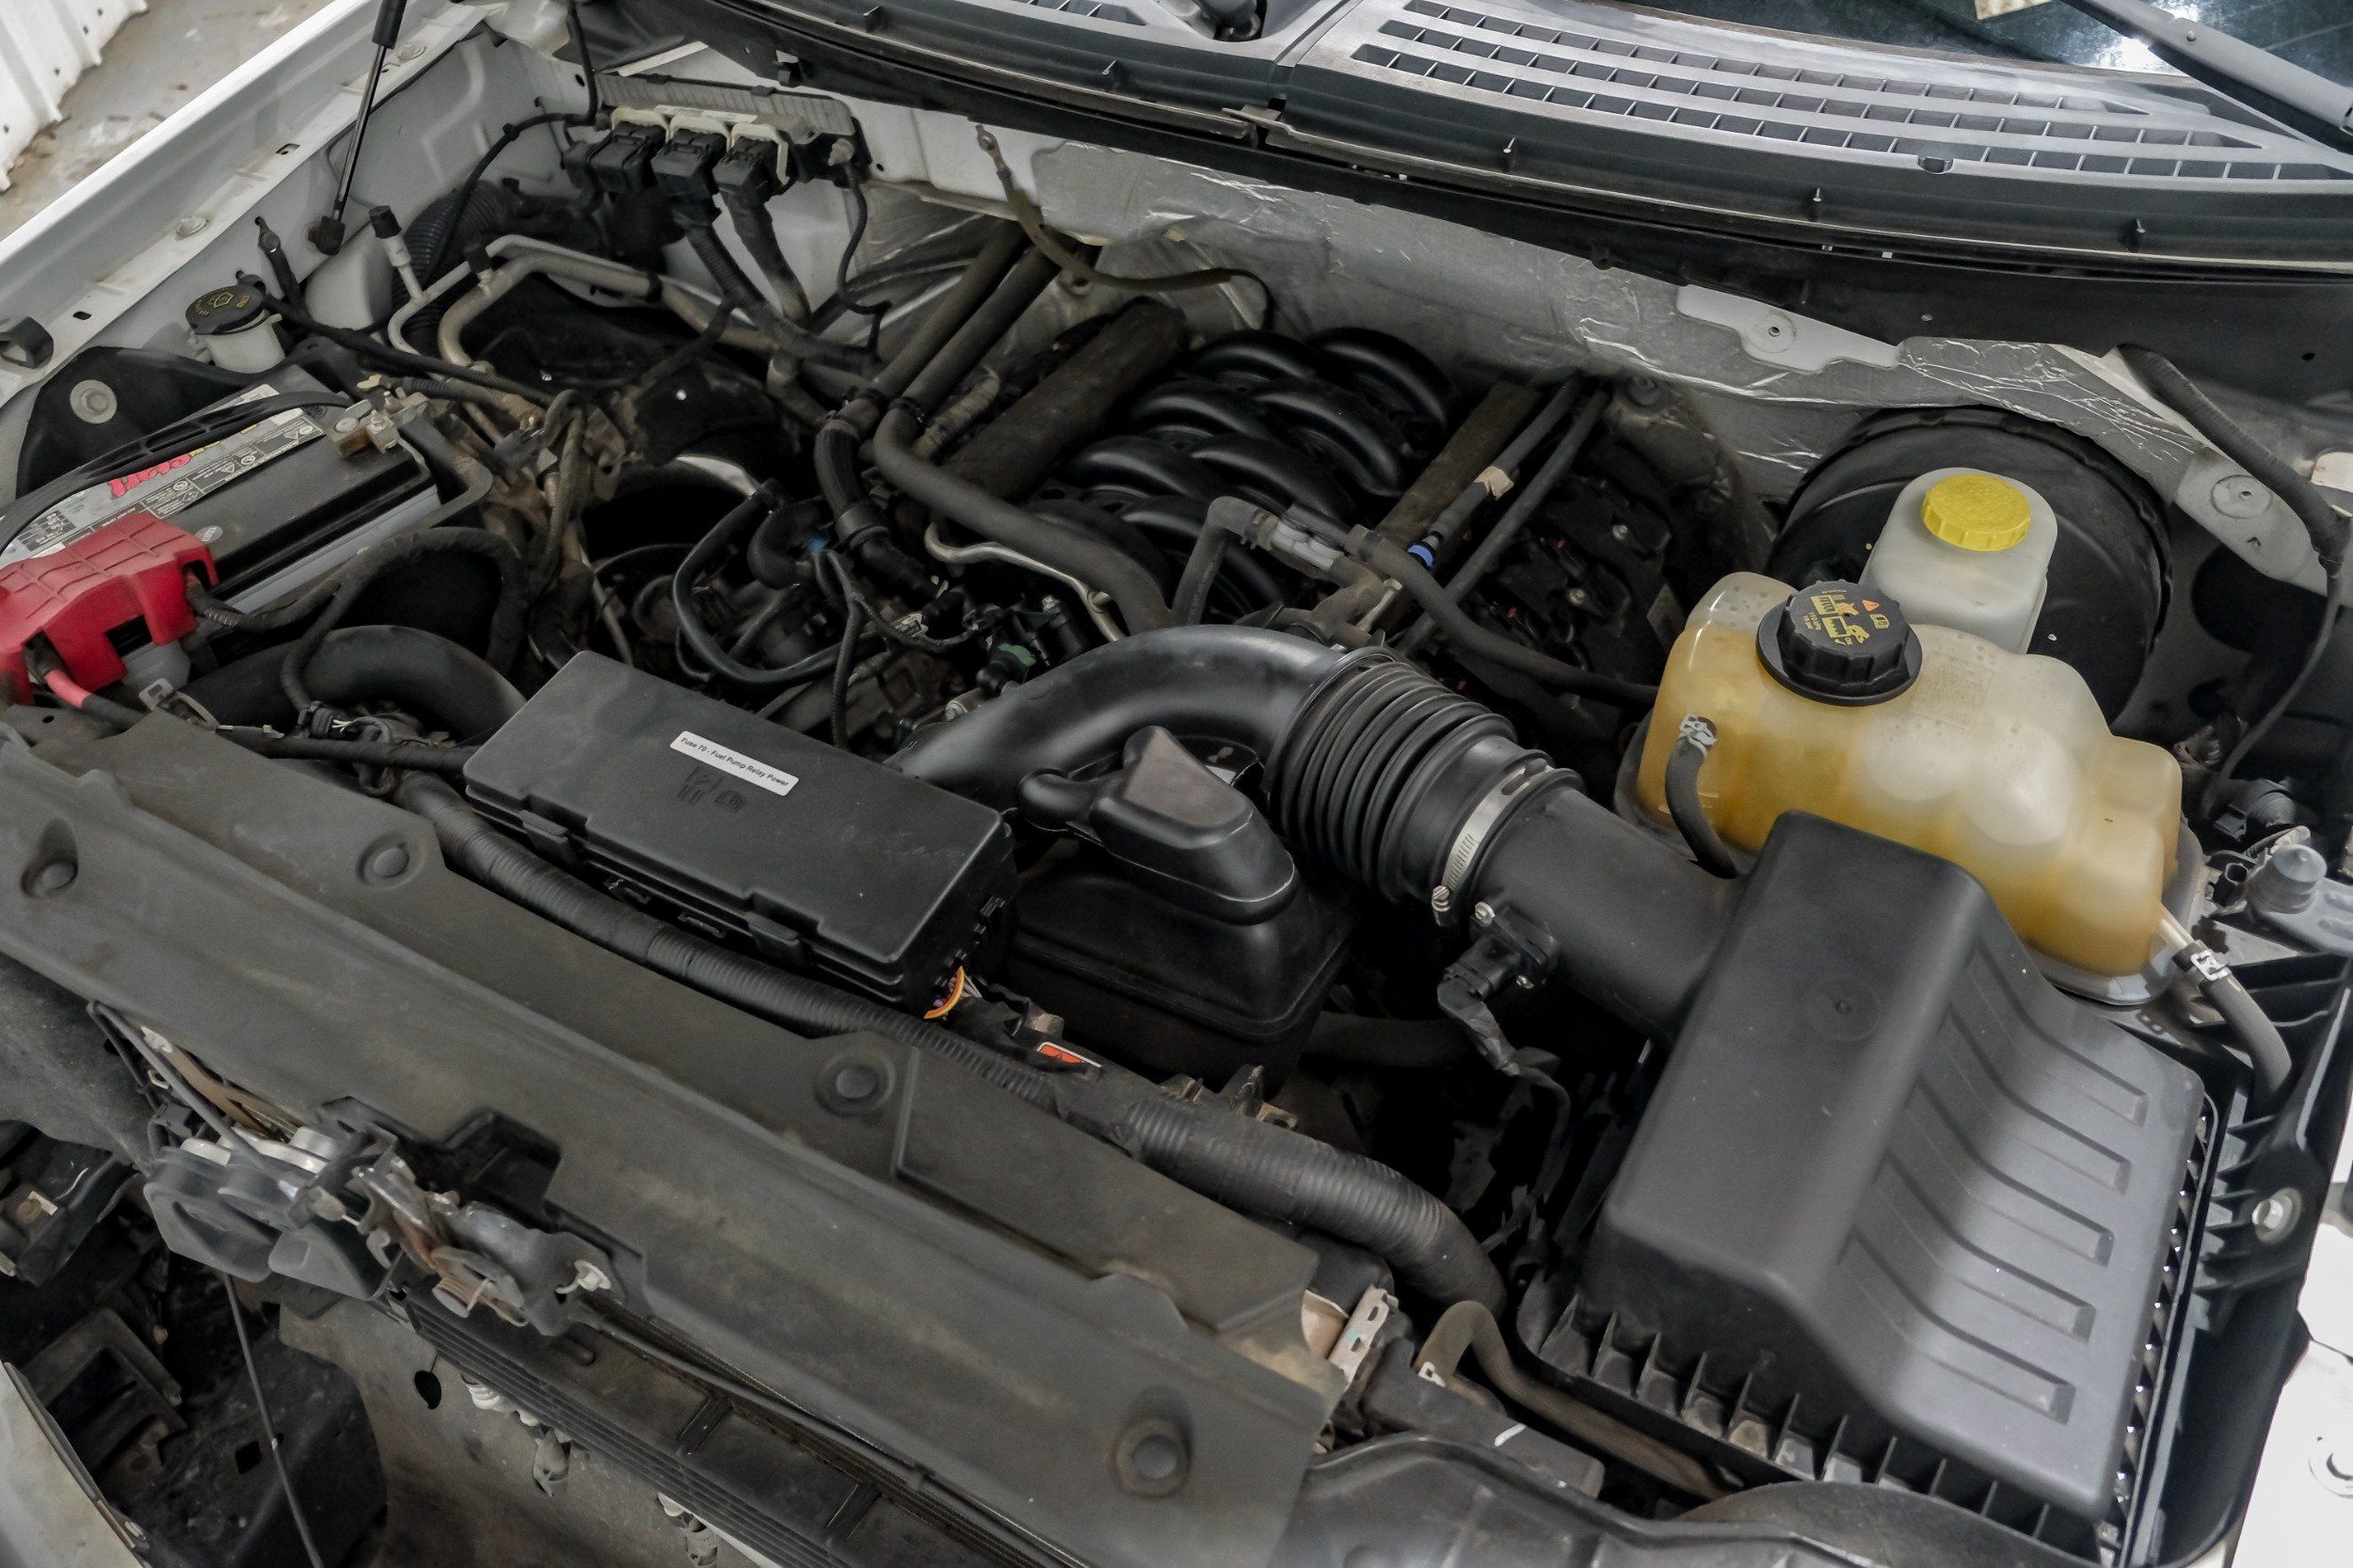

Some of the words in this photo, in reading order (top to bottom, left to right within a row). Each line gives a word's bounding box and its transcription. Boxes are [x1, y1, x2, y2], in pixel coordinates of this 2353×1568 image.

[680, 737, 698, 749] Fuse
[711, 750, 726, 761] Fuel
[726, 756, 746, 769] Pump
[746, 764, 766, 778] Relay
[767, 774, 790, 787] Power
